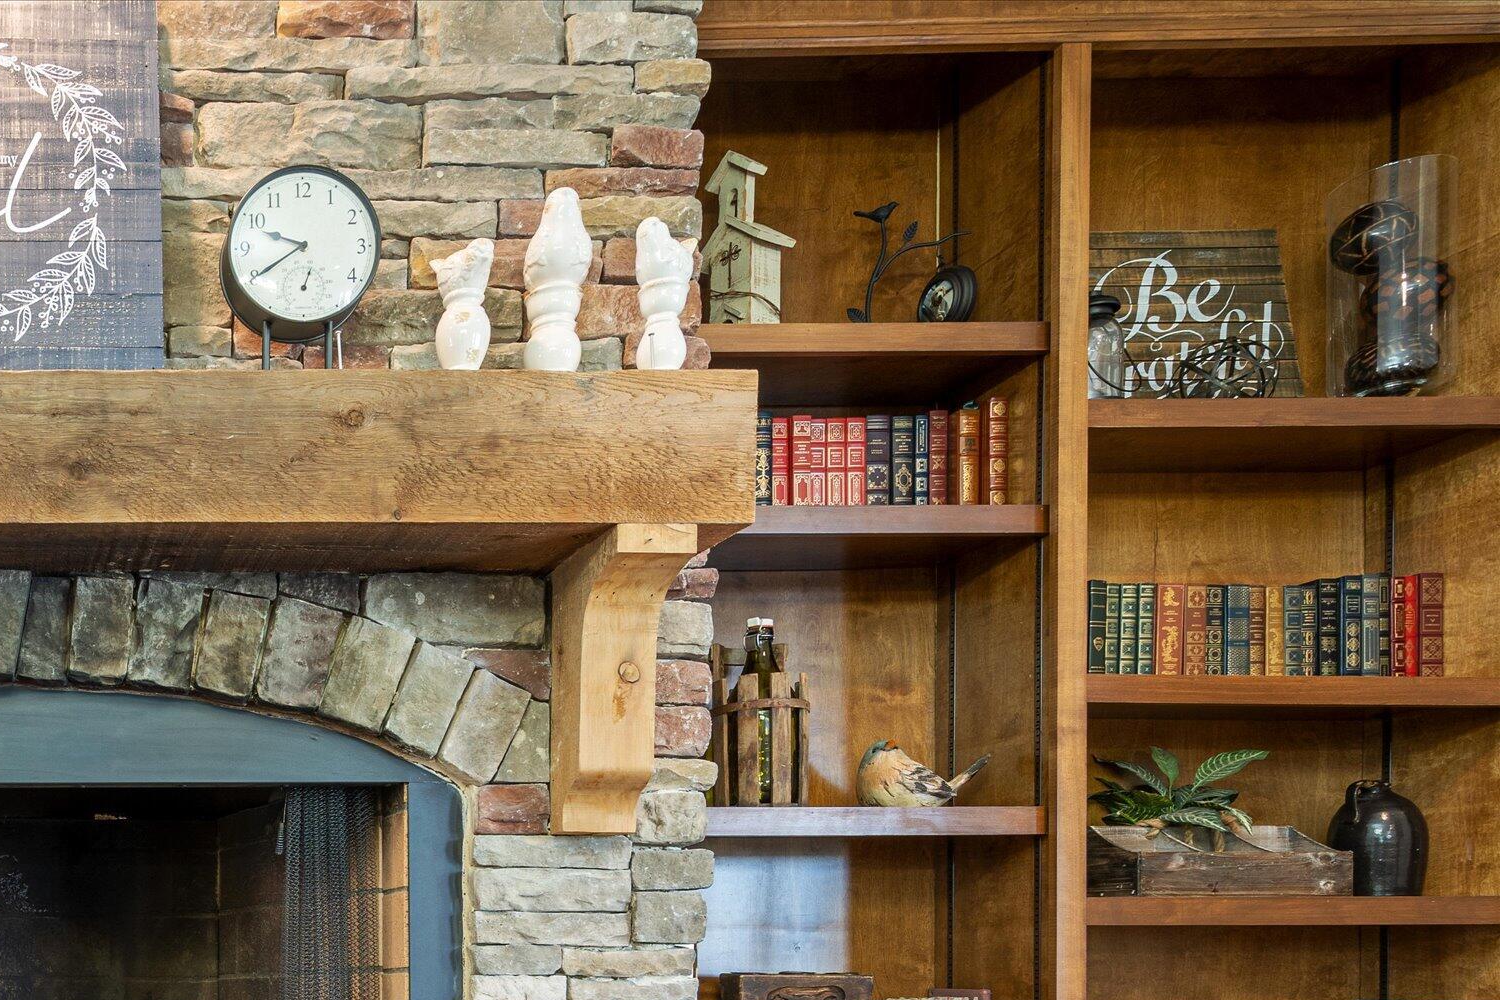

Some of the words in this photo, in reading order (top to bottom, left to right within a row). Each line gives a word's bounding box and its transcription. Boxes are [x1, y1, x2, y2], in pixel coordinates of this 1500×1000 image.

[0, 154, 18, 168] my
[294, 182, 312, 198] 12
[327, 189, 334, 205] 1
[267, 192, 281, 208] 11
[249, 213, 266, 229] 10
[347, 209, 357, 225] 2
[240, 241, 251, 257] 9
[356, 238, 367, 255] 3
[249, 269, 260, 286] 8
[346, 267, 358, 283] 4
[1094, 250, 1235, 341] Be
